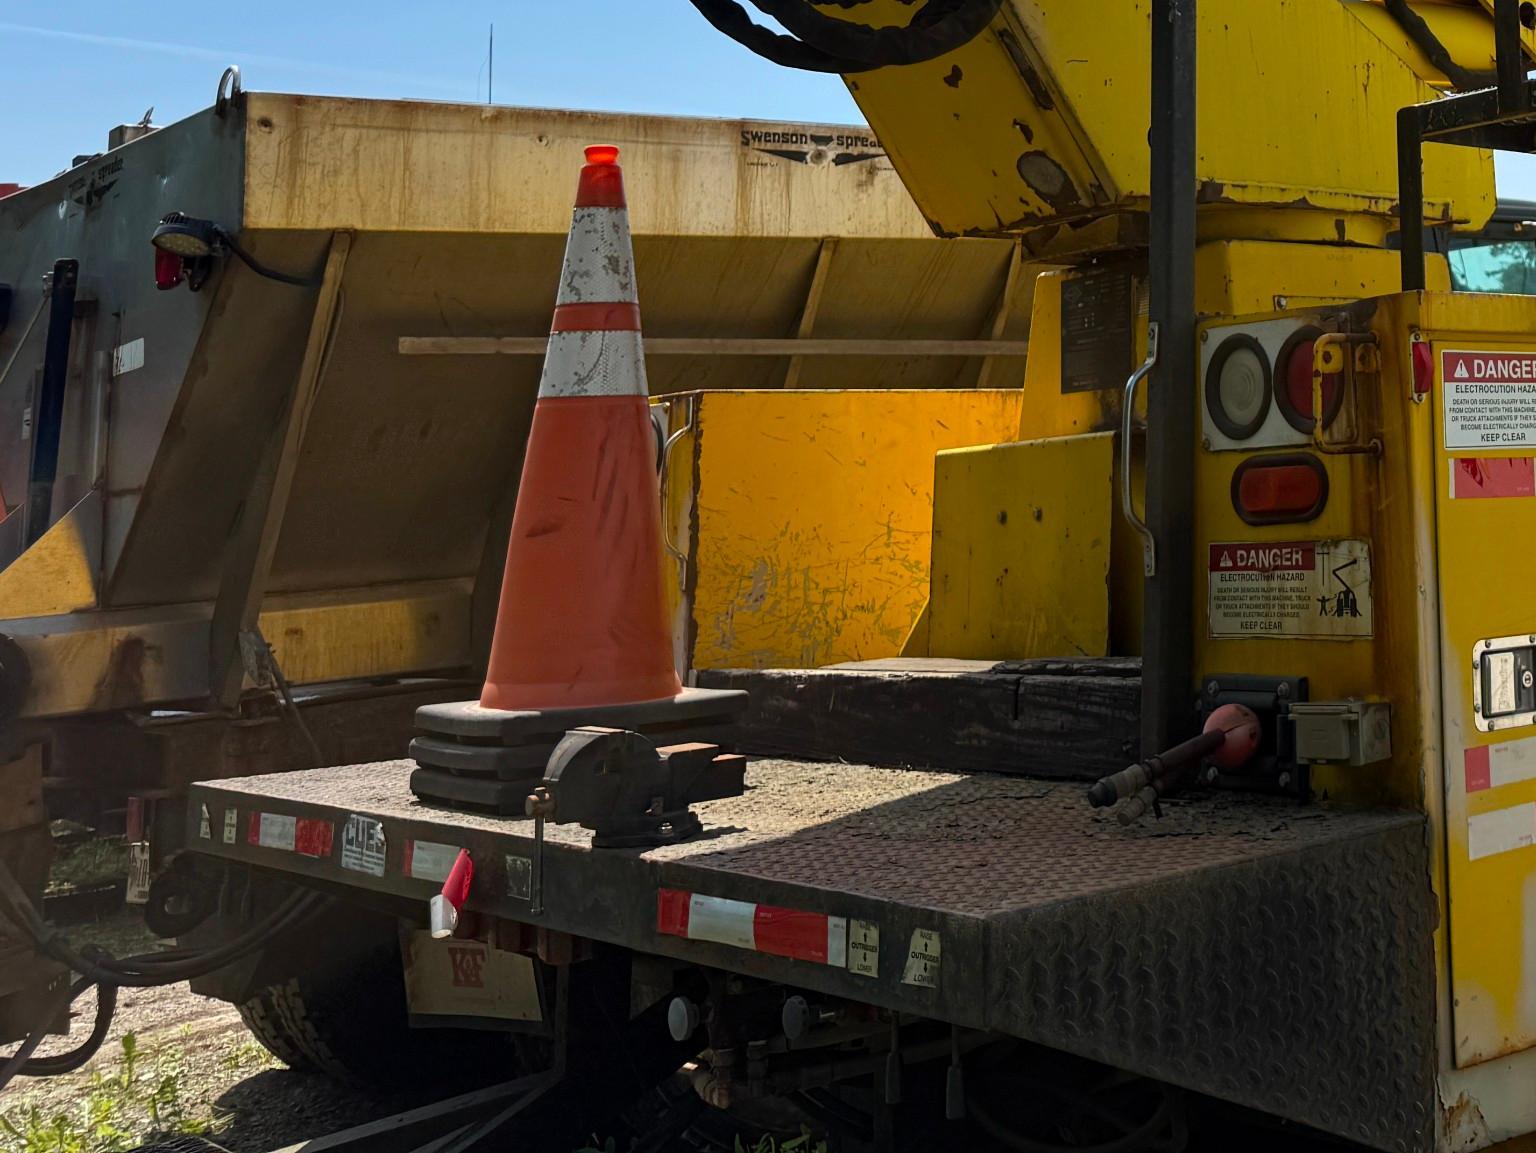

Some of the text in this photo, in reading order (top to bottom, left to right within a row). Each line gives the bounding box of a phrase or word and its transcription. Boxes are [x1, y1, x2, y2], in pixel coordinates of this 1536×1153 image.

[741, 131, 808, 146] Swenson
[1455, 384, 1516, 394] ELECTROCUTION
[1449, 406, 1464, 414] FROM
[1464, 406, 1488, 414] CONTACT
[1502, 406, 1513, 414] THIS
[1451, 415, 1460, 423] OR
[1460, 423, 1482, 431] BECOME
[1481, 432, 1526, 442] KEEP CLEAR
[1236, 548, 1303, 568] DANGER
[1220, 572, 1305, 582] ELECTROCUTION HAZARD
[1240, 621, 1283, 630] KEEP CLEAR
[911, 951, 939, 963] OUTRIGGER
